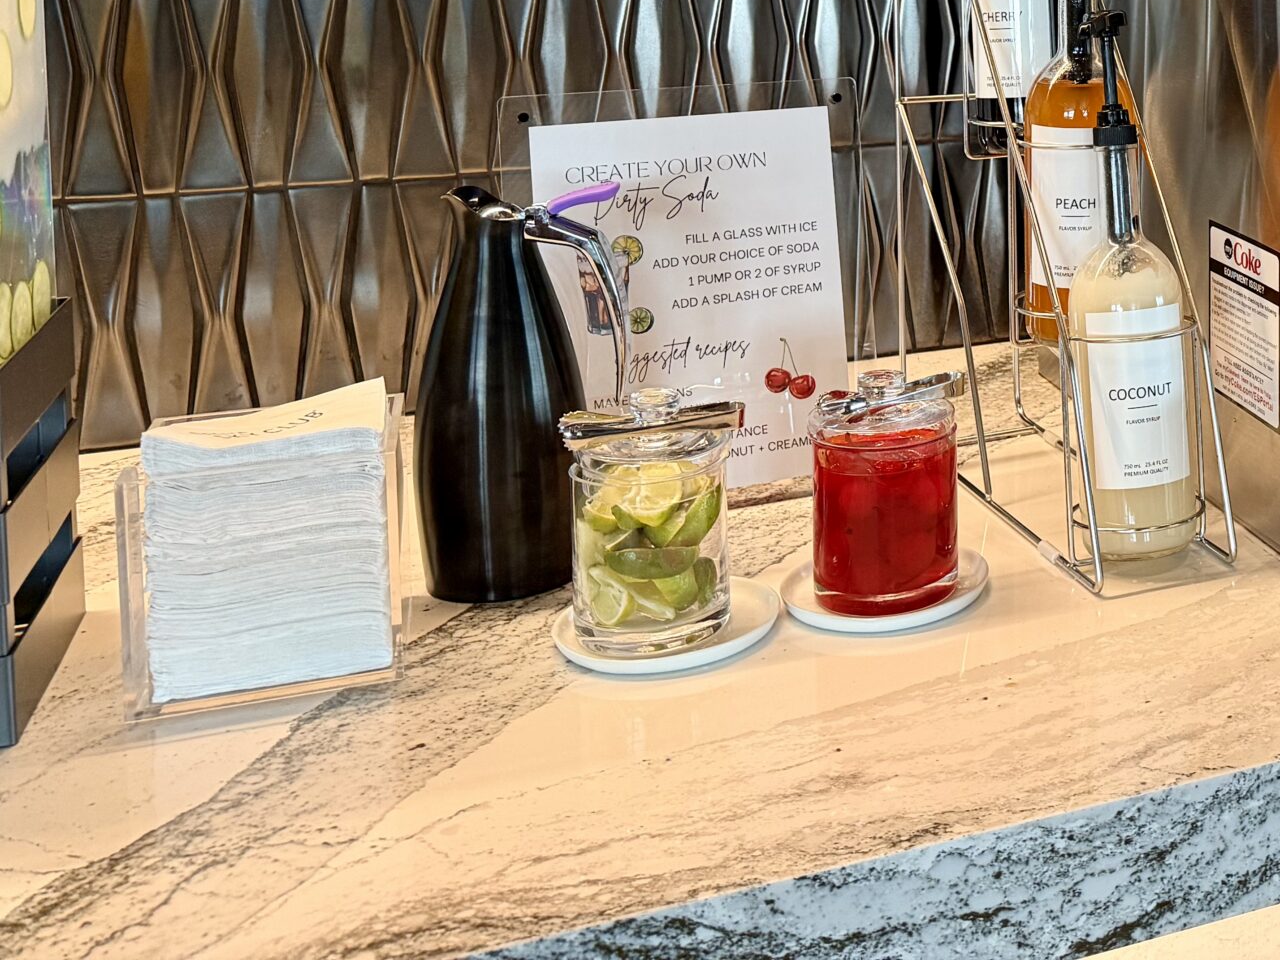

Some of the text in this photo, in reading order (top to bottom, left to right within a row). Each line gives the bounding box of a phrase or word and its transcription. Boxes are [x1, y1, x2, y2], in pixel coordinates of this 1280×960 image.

[982, 11, 1023, 23] CHERR
[565, 151, 767, 185] CREATE YOUR OWN
[662, 175, 719, 219] Soda
[1055, 198, 1096, 210] PEACH
[685, 220, 818, 245] FILL A GLASS WITH ICE
[652, 240, 820, 270] ADD YOUR CHOICE OF SODA
[1234, 242, 1262, 276] Coke
[688, 261, 821, 287] 1 PUMP OR 2 OF SYRUP
[1223, 267, 1265, 295] EQUIPMENT ISSUE?
[672, 281, 823, 310] ADD A SPLASH OF CREAM
[628, 336, 752, 384] ggested recipes
[1108, 381, 1172, 401] COCONUT
[263, 410, 323, 433] CLUB
[1126, 417, 1145, 425] FLAVOR
[767, 435, 813, 452] CREAM
[1124, 469, 1149, 478] PREMIUM
